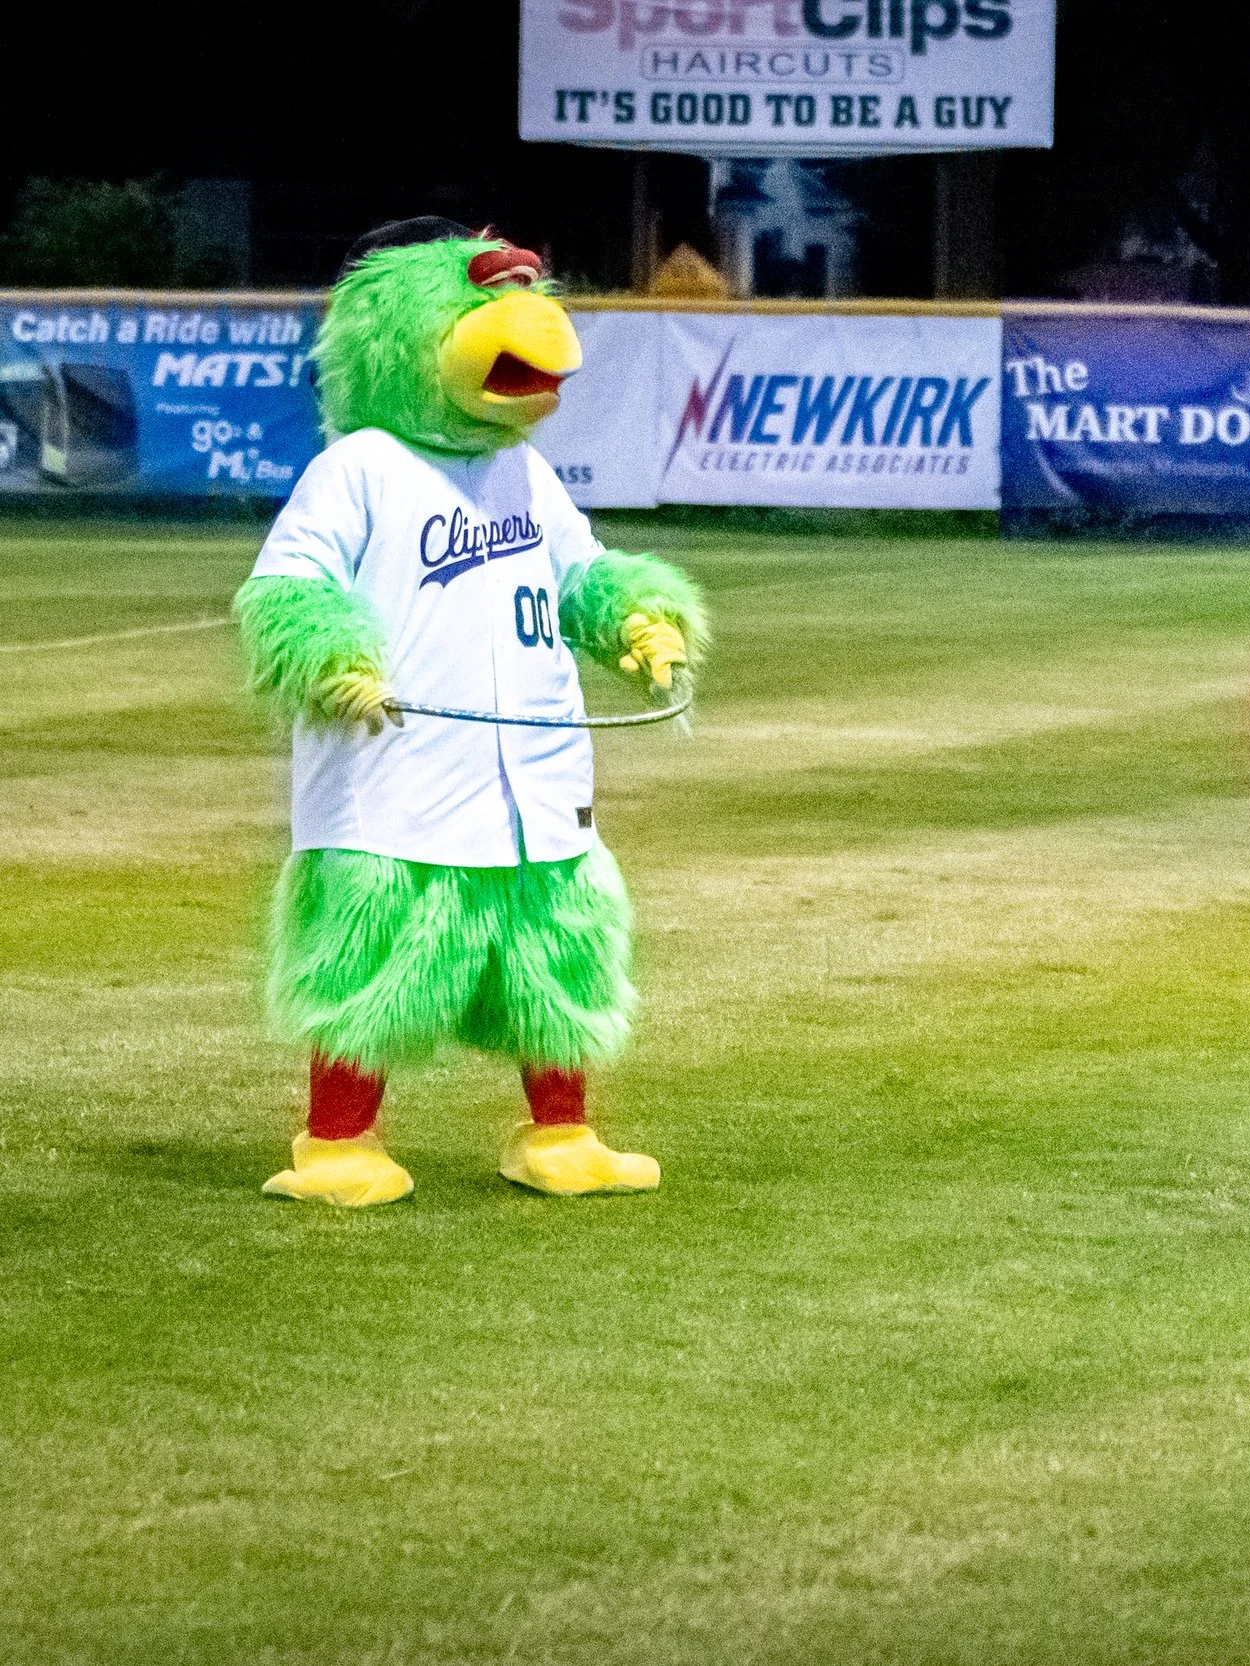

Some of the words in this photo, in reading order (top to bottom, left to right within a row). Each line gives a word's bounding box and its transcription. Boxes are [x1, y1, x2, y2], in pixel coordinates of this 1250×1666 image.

[652, 50, 894, 77] HAIRCUTS
[555, 89, 636, 124] IT'S
[649, 92, 752, 127] GOOD
[765, 94, 816, 128] TO
[829, 95, 881, 129] BE
[894, 96, 920, 130] A
[934, 97, 1012, 130] GUY
[12, 311, 110, 343] Catch
[117, 319, 138, 344] a
[145, 313, 221, 344] Ride
[228, 315, 302, 345] with
[1004, 355, 1090, 398] The
[708, 374, 991, 447] NEWKIRK
[1027, 403, 1170, 444] MART
[700, 451, 815, 472] ELECTRIC
[825, 454, 971, 475] ASSOCIATES
[420, 506, 543, 568] Clippers
[514, 585, 554, 650] 00
